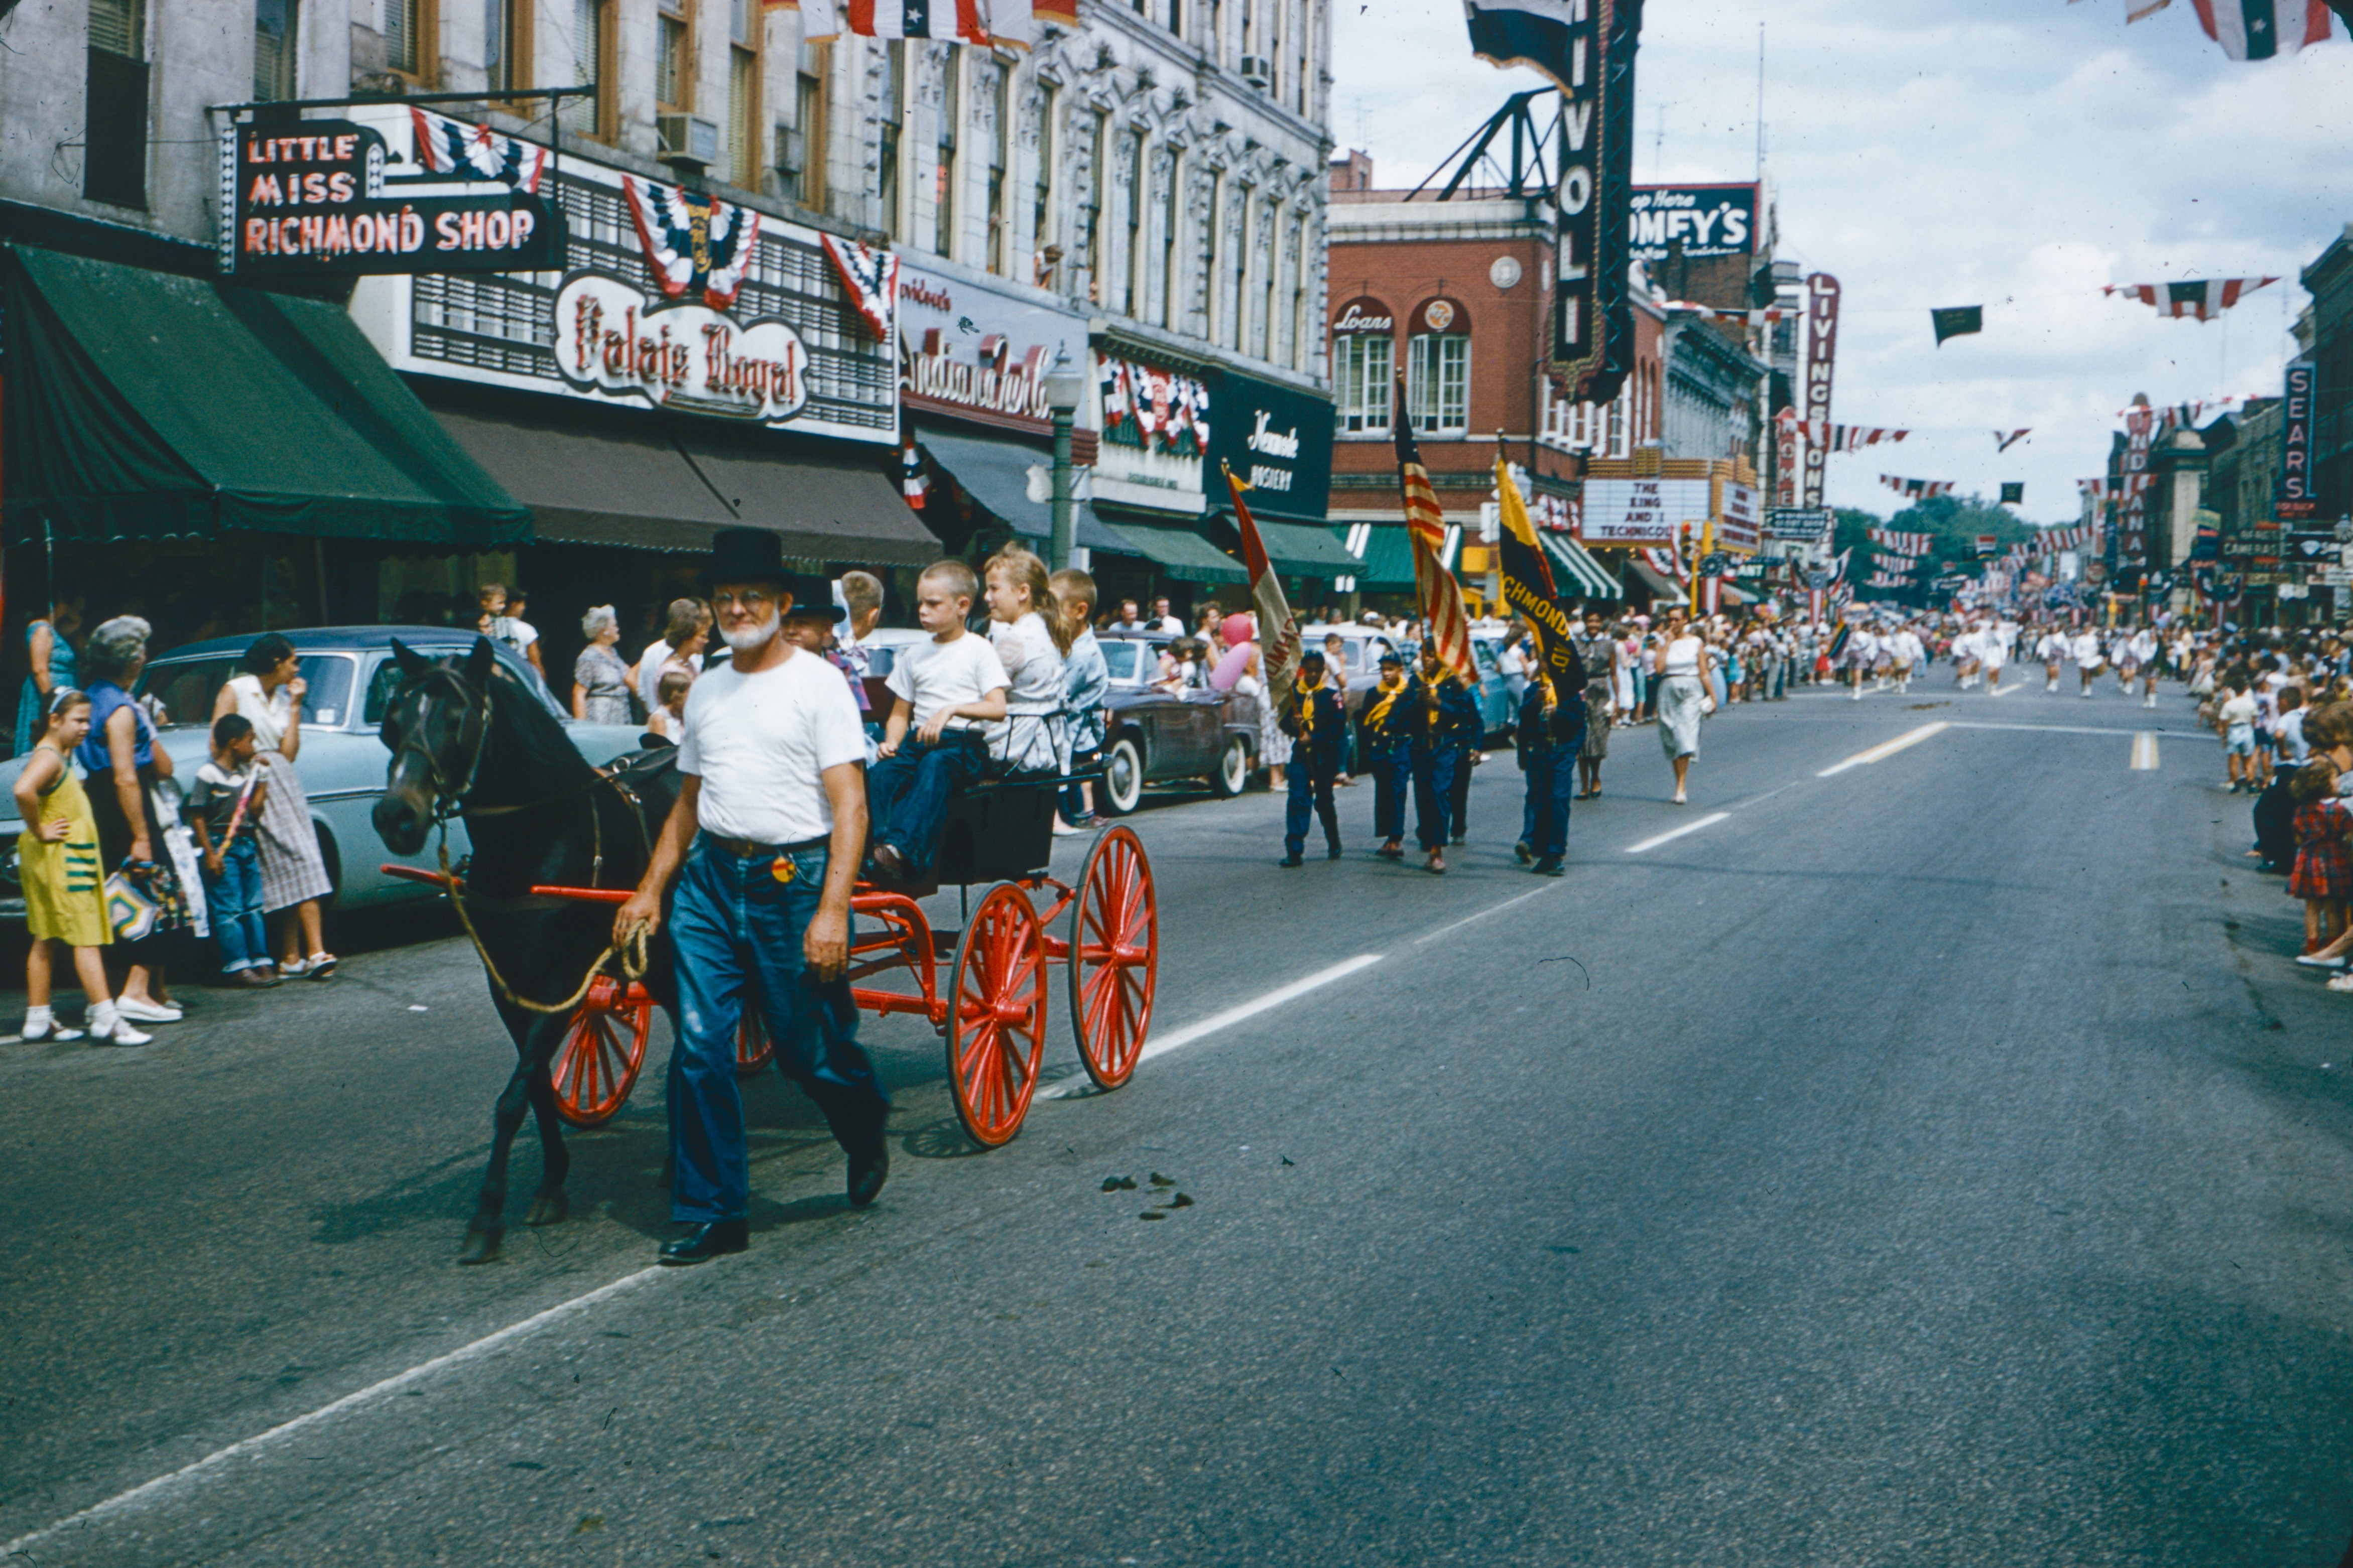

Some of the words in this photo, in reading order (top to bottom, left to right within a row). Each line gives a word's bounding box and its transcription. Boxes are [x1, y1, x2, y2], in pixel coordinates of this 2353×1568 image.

[249, 135, 354, 163] LITTLE
[250, 172, 354, 207] MISS
[1630, 193, 1652, 214] op
[1652, 189, 1696, 208] Here
[245, 211, 425, 255] RICHMOND
[435, 208, 535, 251] SHOP
[1333, 304, 1393, 331] Loans
[574, 294, 689, 386] Palais
[701, 323, 796, 405] Royal
[1806, 276, 1836, 509] LIVINGSONS
[2285, 370, 2308, 499] SEARS
[1634, 482, 1659, 494] THE
[2128, 413, 2150, 551] INDANA
[1625, 512, 1652, 522] AND
[1660, 511, 1665, 522] I
[1630, 497, 1661, 508] KING
[1600, 525, 1672, 537] TECHNICOL
[1504, 575, 1571, 641] CHMOND,
